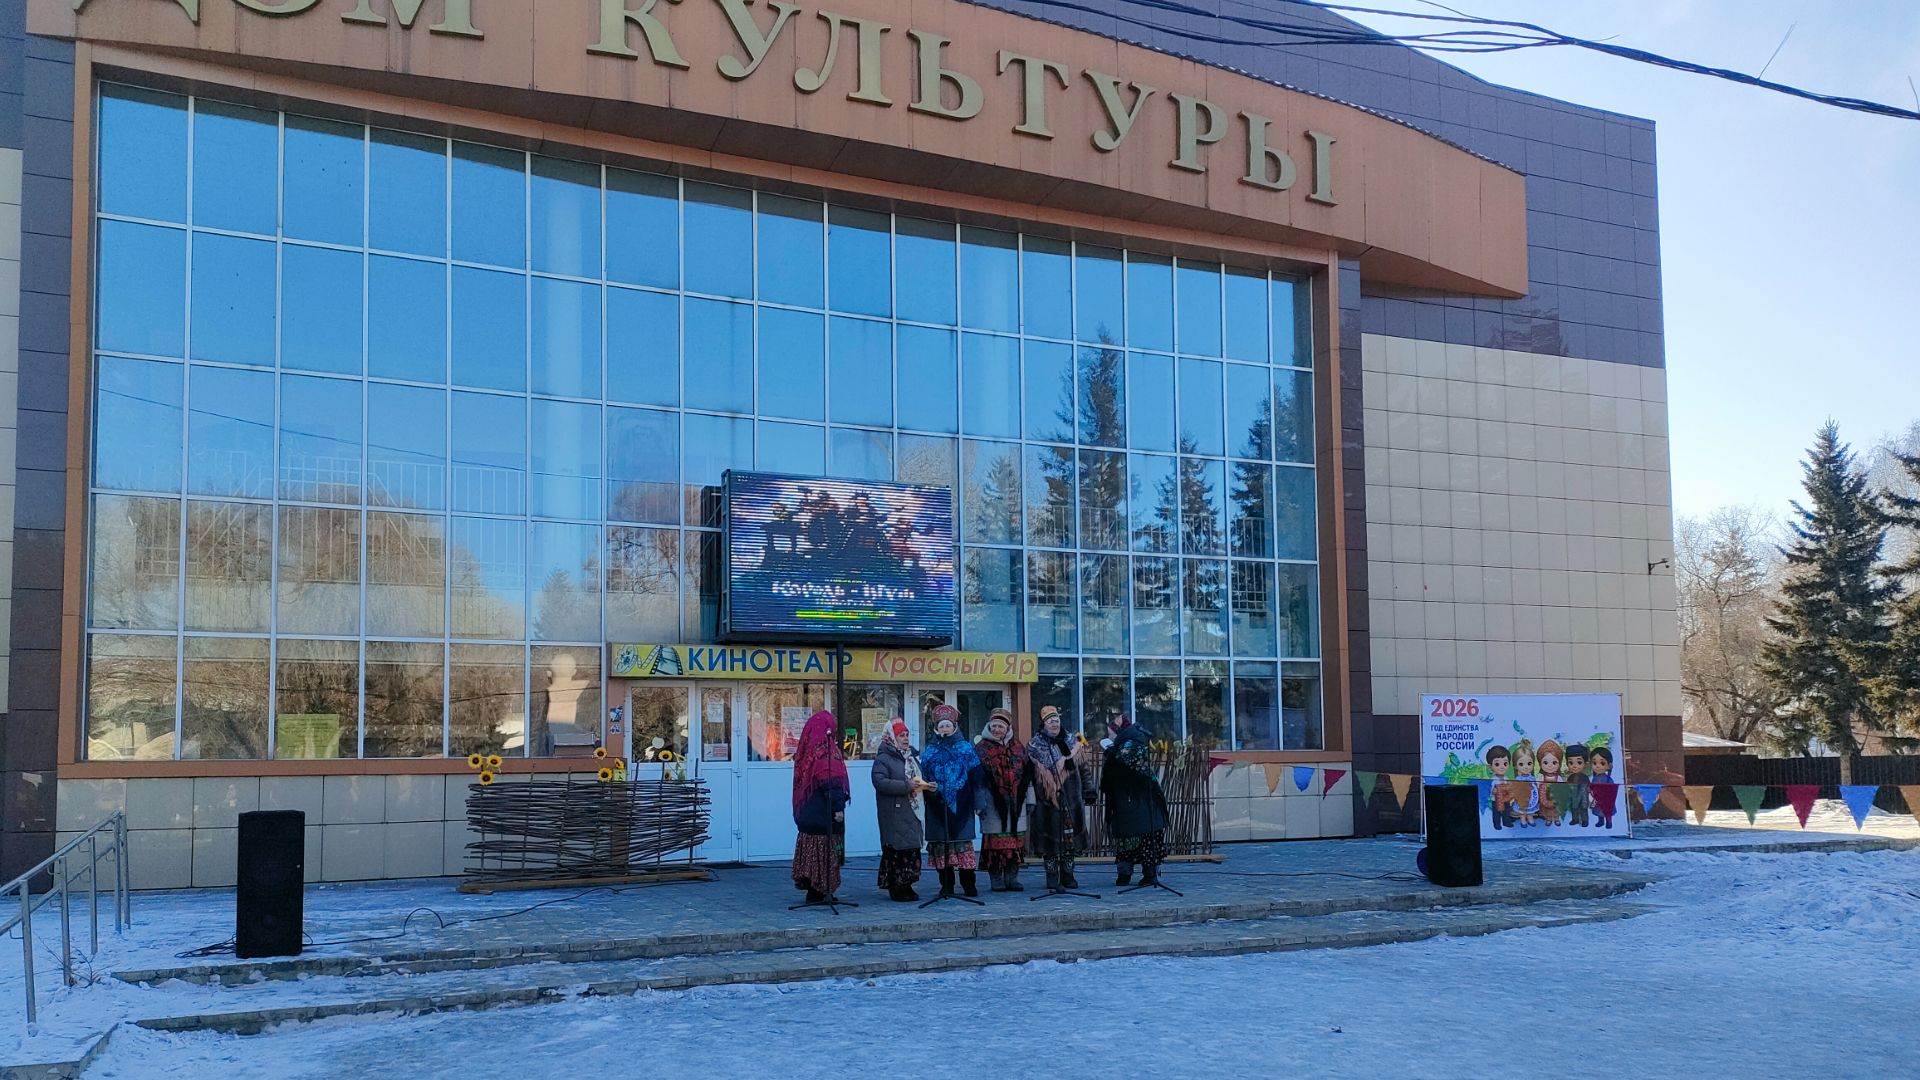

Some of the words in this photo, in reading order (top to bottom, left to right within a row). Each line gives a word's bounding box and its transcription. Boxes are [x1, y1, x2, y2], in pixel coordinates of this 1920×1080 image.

[587, 0, 1339, 206] КУЛЬТУРЫ
[687, 647, 853, 674] КИНОТЕАТР
[873, 651, 994, 678] Красный
[1002, 654, 1036, 680] Яр
[1430, 698, 1480, 717] 2026
[1430, 724, 1443, 732] ГОД
[1444, 724, 1480, 732] ЕДИНСТВА
[1436, 732, 1474, 741] НАРОДОВ
[1436, 741, 1475, 750] РОССИИ
